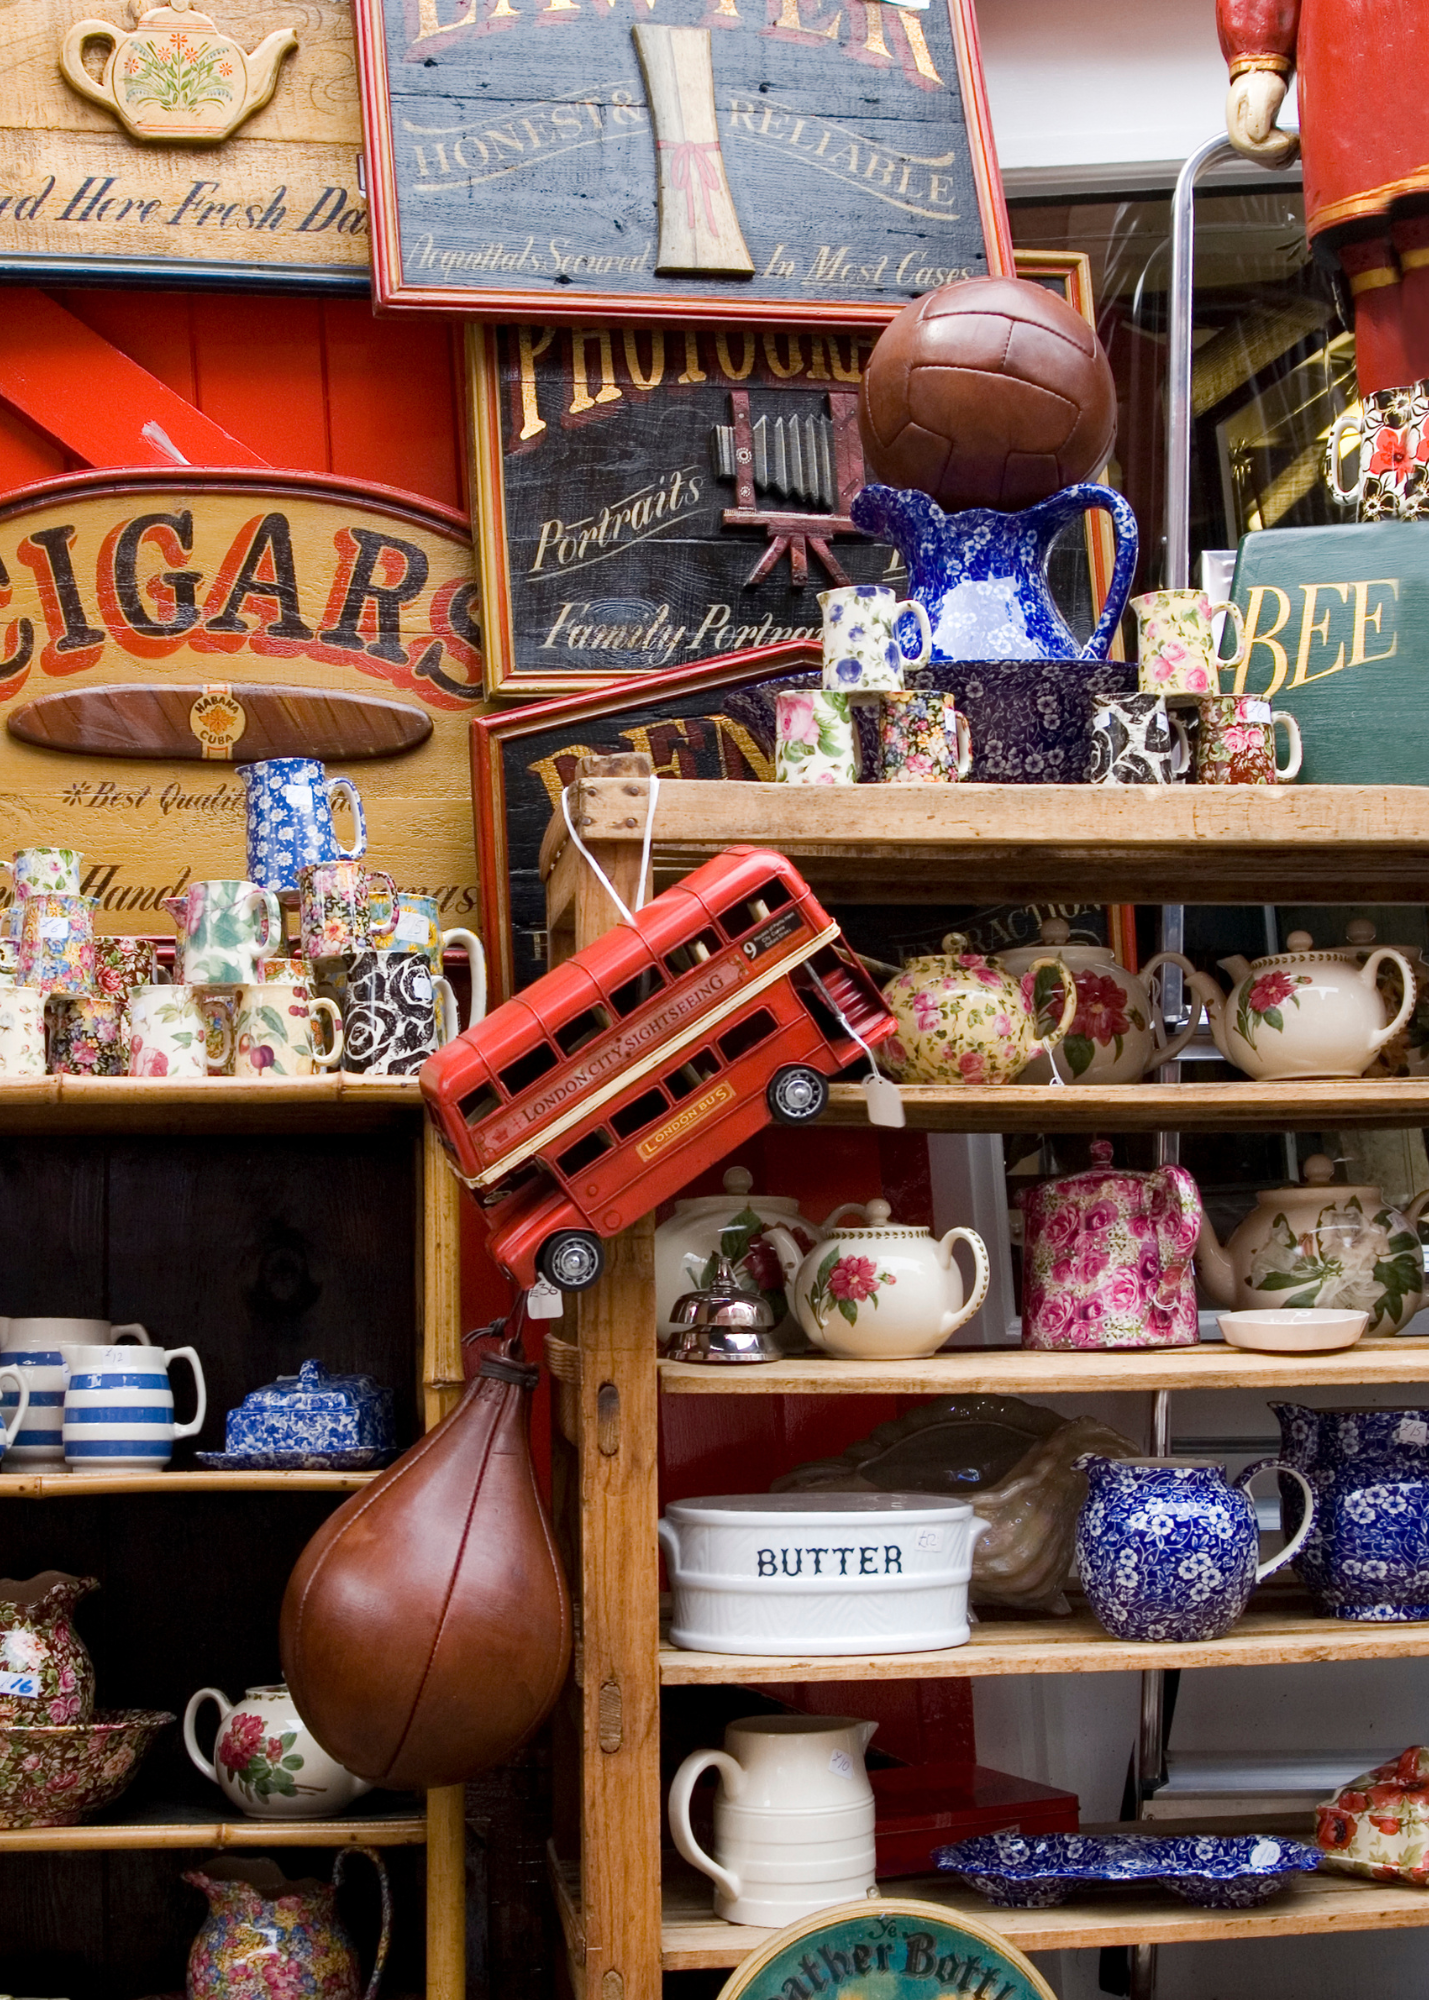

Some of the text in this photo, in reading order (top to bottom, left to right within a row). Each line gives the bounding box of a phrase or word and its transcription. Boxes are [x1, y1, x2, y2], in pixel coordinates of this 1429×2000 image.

[413, 89, 956, 205] HONEST & RELIABLE
[55, 176, 162, 223] Here
[165, 181, 288, 232] Fresh
[294, 187, 369, 236] Da
[542, 238, 651, 275] Secured
[762, 243, 795, 279] In
[802, 245, 889, 286] Most
[895, 251, 974, 287] Cases
[528, 471, 704, 573] Portraits
[541, 602, 687, 667] Family
[200, 730, 234, 746] CUBA
[84, 781, 152, 809] Best
[79, 864, 191, 912] Hand
[743, 941, 758, 960] 9
[521, 974, 725, 1123] LONDON CITY SIGHTSEEING
[644, 1087, 728, 1153] LONDON BUS
[757, 1545, 903, 1577] BUTTER
[867, 1916, 898, 1940] Ye
